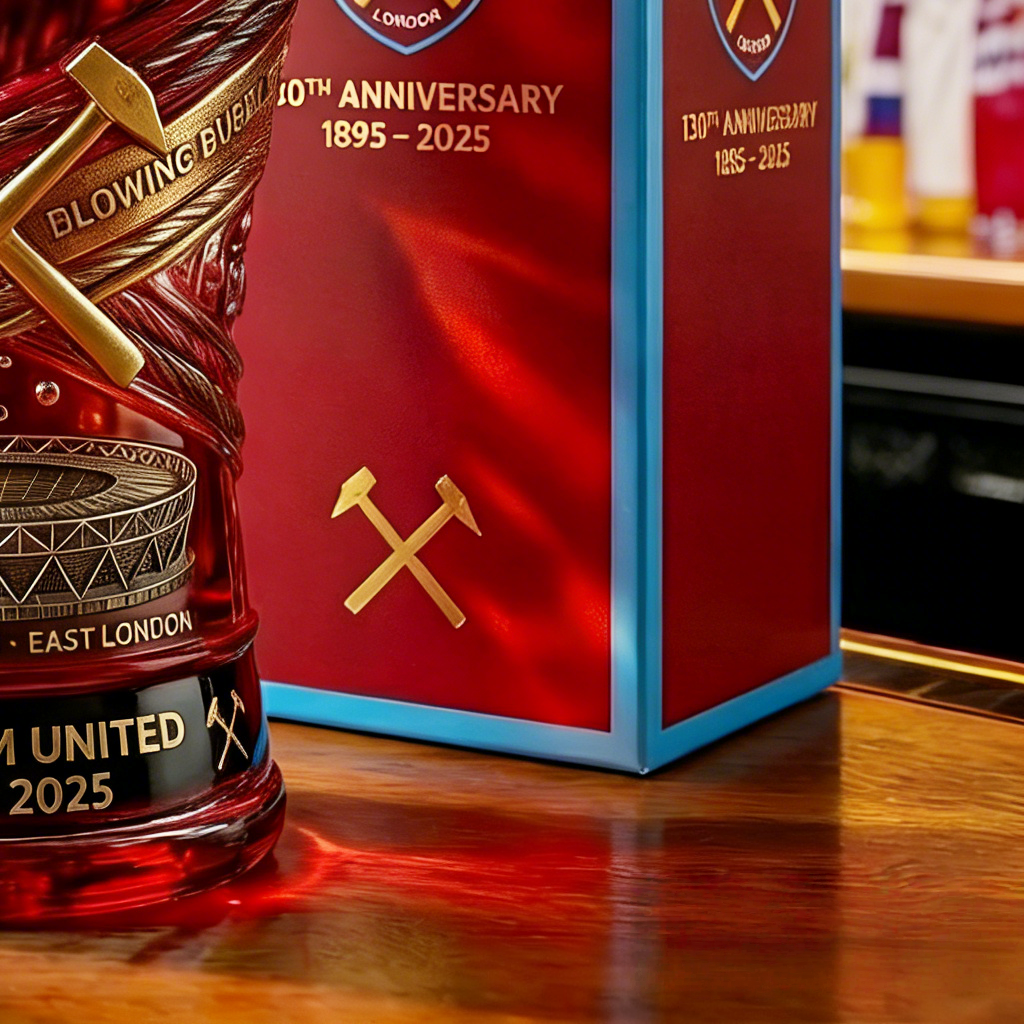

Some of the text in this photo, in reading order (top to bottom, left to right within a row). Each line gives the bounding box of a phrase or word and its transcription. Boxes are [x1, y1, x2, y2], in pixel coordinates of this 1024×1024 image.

[338, 79, 564, 115] ANNIVERSARY
[321, 119, 387, 149] 1895
[416, 123, 491, 153] 2025
[46, 143, 194, 239] BLOWING
[29, 627, 96, 654] EAST
[101, 610, 194, 648] LONDON
[31, 710, 187, 764] UNITED
[8, 772, 114, 816] 2025
